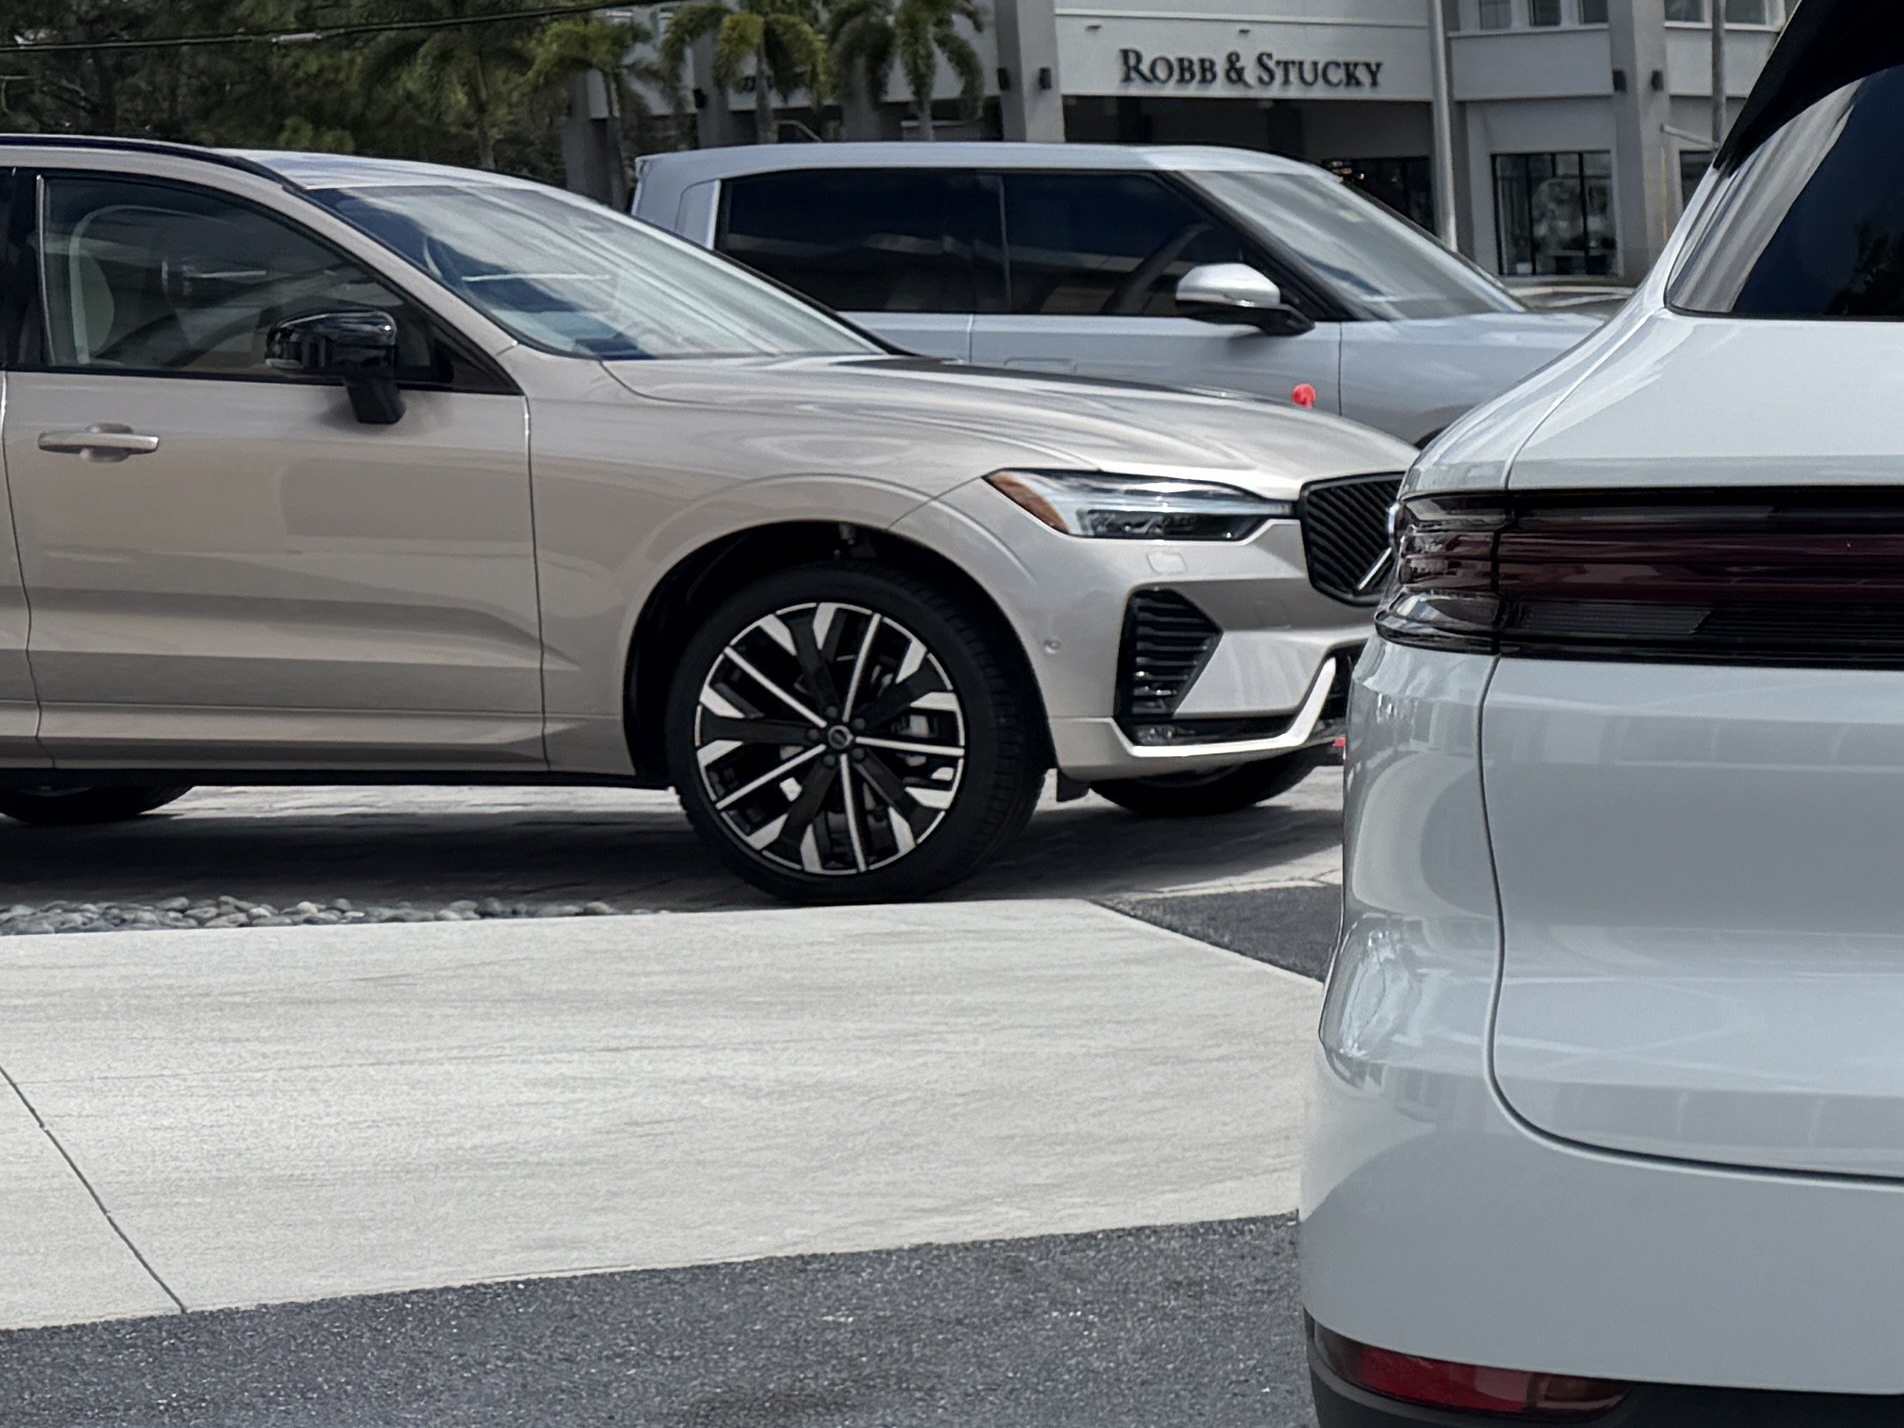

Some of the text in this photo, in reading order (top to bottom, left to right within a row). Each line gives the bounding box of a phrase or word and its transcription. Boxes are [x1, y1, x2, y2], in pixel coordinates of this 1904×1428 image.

[1119, 48, 1383, 90] ROBB & STUCKY
